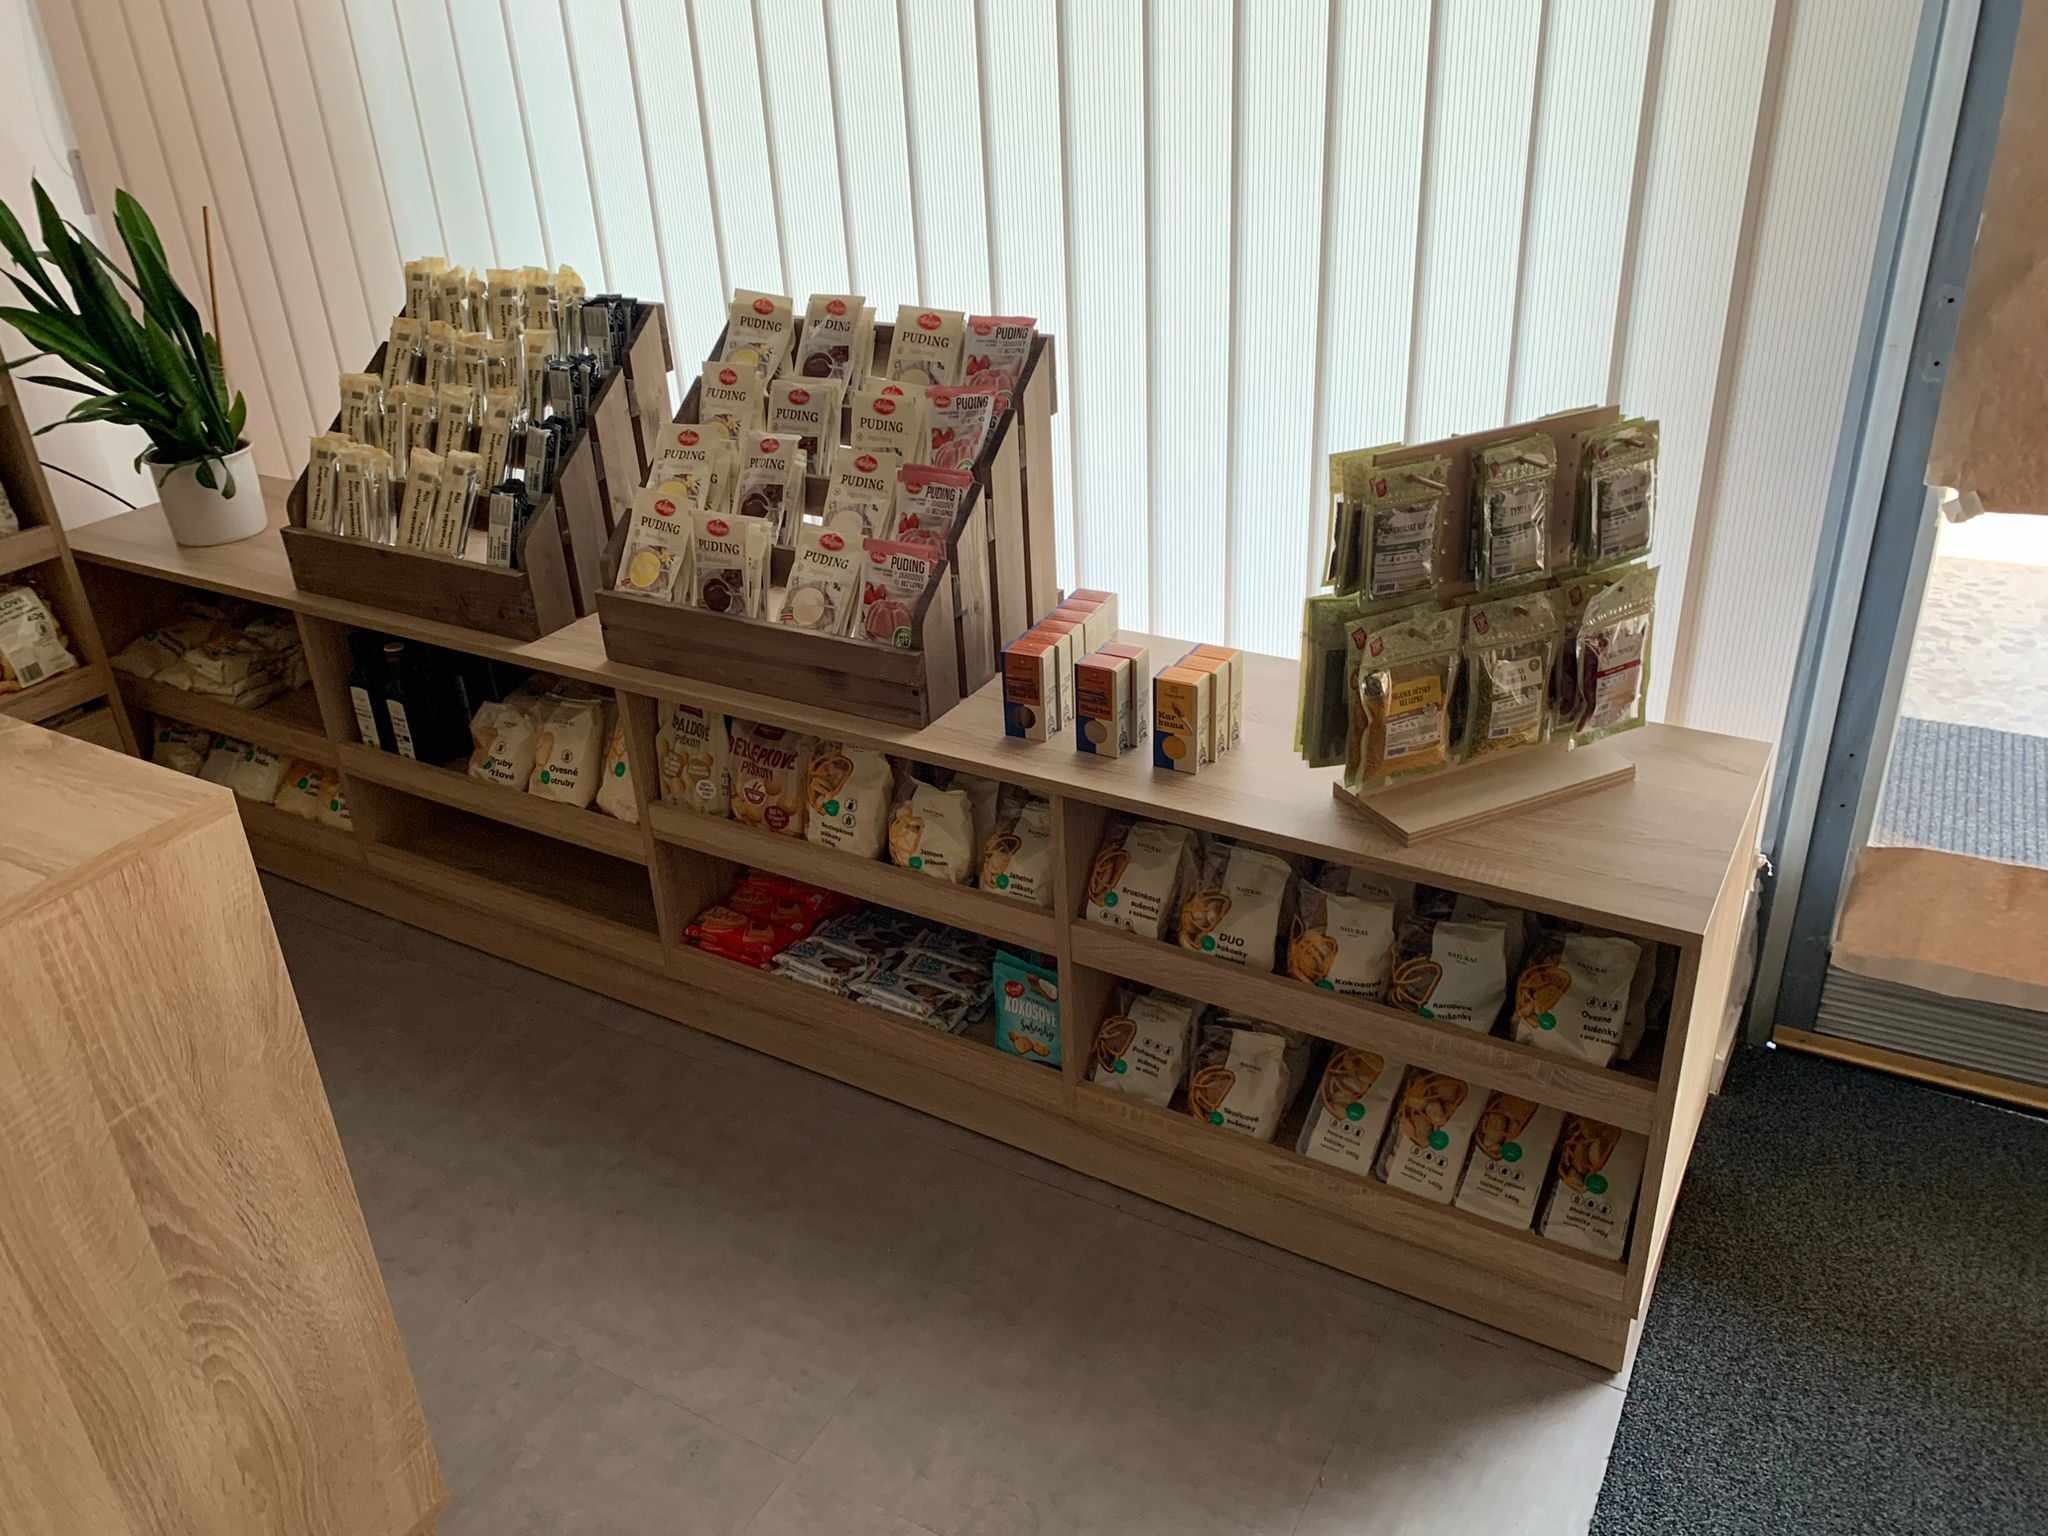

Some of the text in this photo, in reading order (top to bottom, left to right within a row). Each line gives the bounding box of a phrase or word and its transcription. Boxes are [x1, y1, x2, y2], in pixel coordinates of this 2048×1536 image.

[740, 315, 782, 333] PUDING
[902, 331, 950, 348] PUDING
[995, 327, 1029, 340] PUDING
[706, 387, 746, 402] PUDING
[956, 396, 989, 410] PUDING
[776, 407, 819, 422] PUDING
[860, 417, 903, 433] PUDING
[664, 448, 706, 461] PUDING
[750, 457, 785, 471] PUDING
[841, 474, 885, 491] PUDING
[925, 486, 956, 501] PUDING
[641, 516, 681, 535] PUDING
[698, 540, 740, 556] PUDING
[803, 550, 849, 570] PUDING
[891, 556, 925, 574] PUDING
[549, 764, 578, 777] Ovesné
[550, 778, 576, 789] otruby
[1219, 932, 1245, 947] DUO
